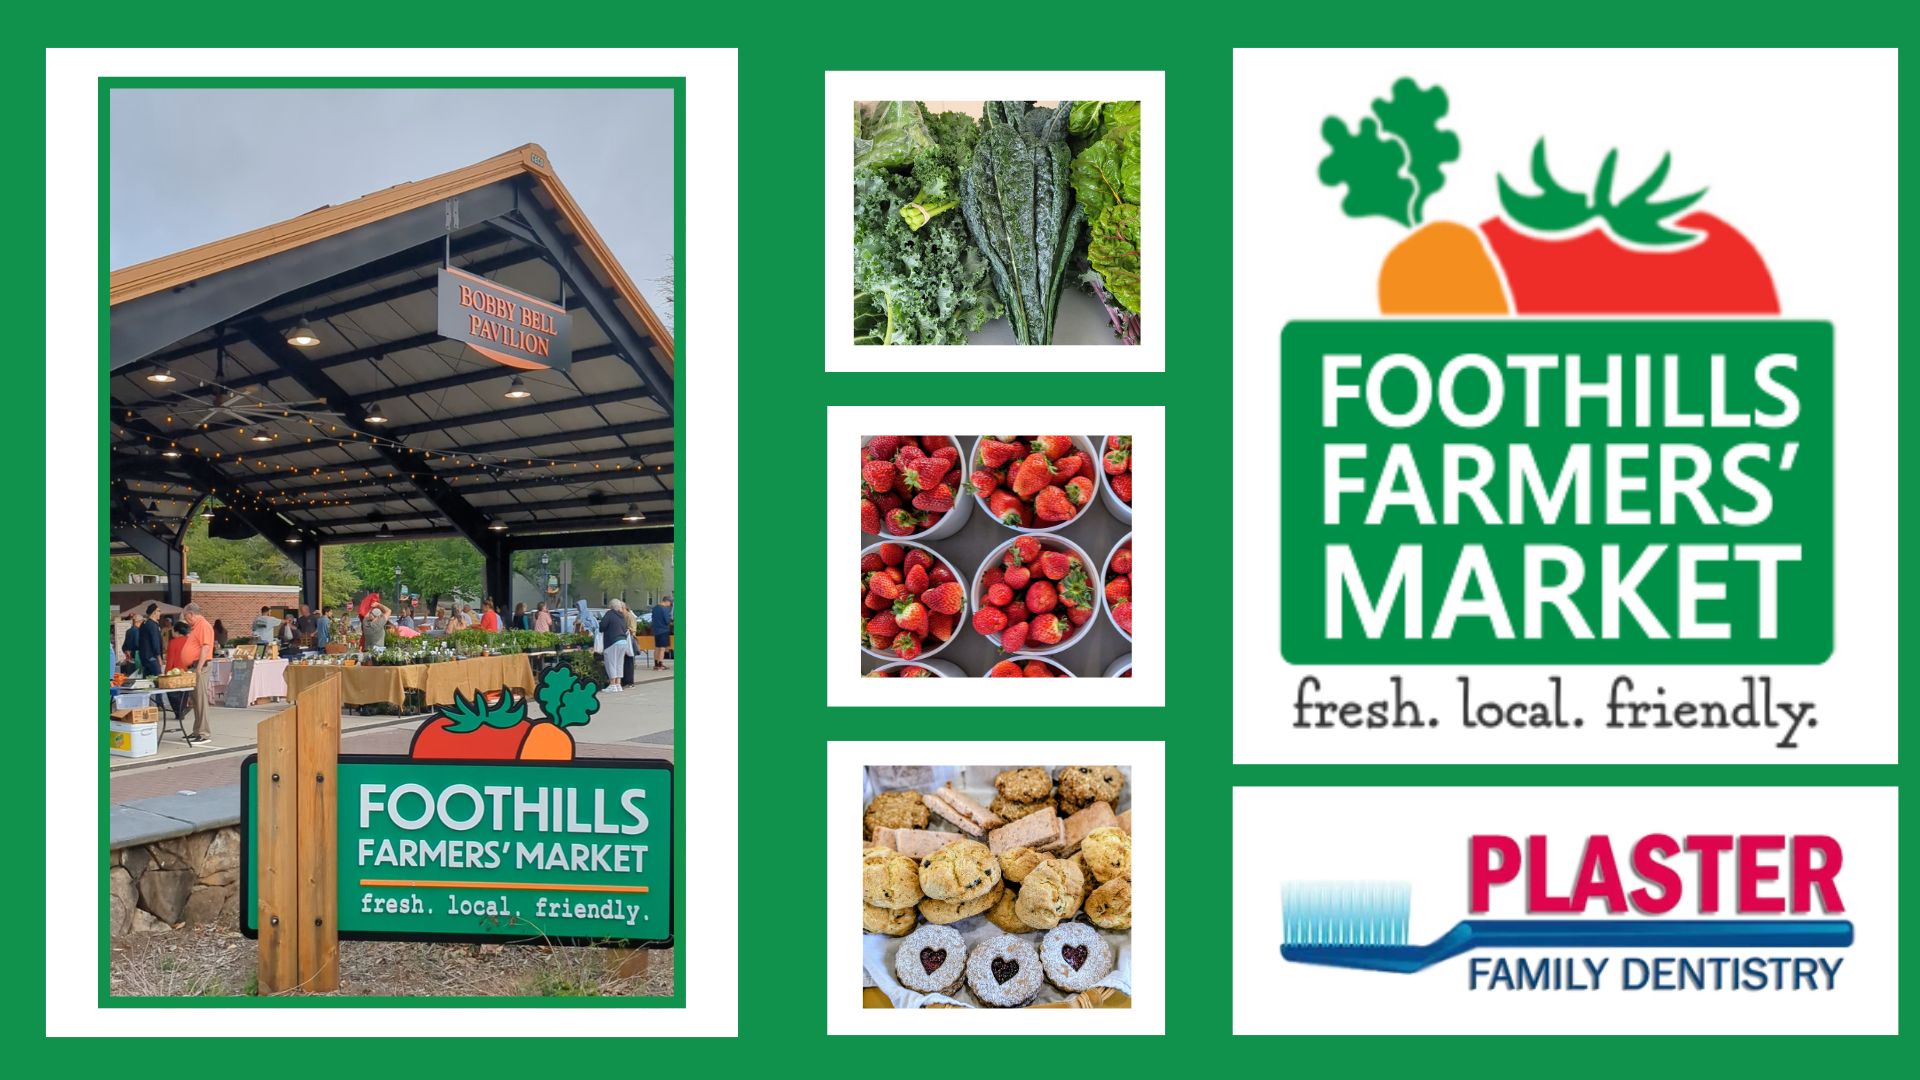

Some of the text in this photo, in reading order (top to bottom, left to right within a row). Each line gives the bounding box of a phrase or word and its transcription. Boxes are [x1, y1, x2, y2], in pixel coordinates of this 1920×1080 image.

[459, 284, 557, 336] BOBBY BELL
[469, 313, 549, 357] PAVILION
[359, 783, 650, 835] FOOTHILLS
[358, 838, 649, 873] FARMERS' MARKET
[361, 893, 649, 926] fresh. local. friendly.
